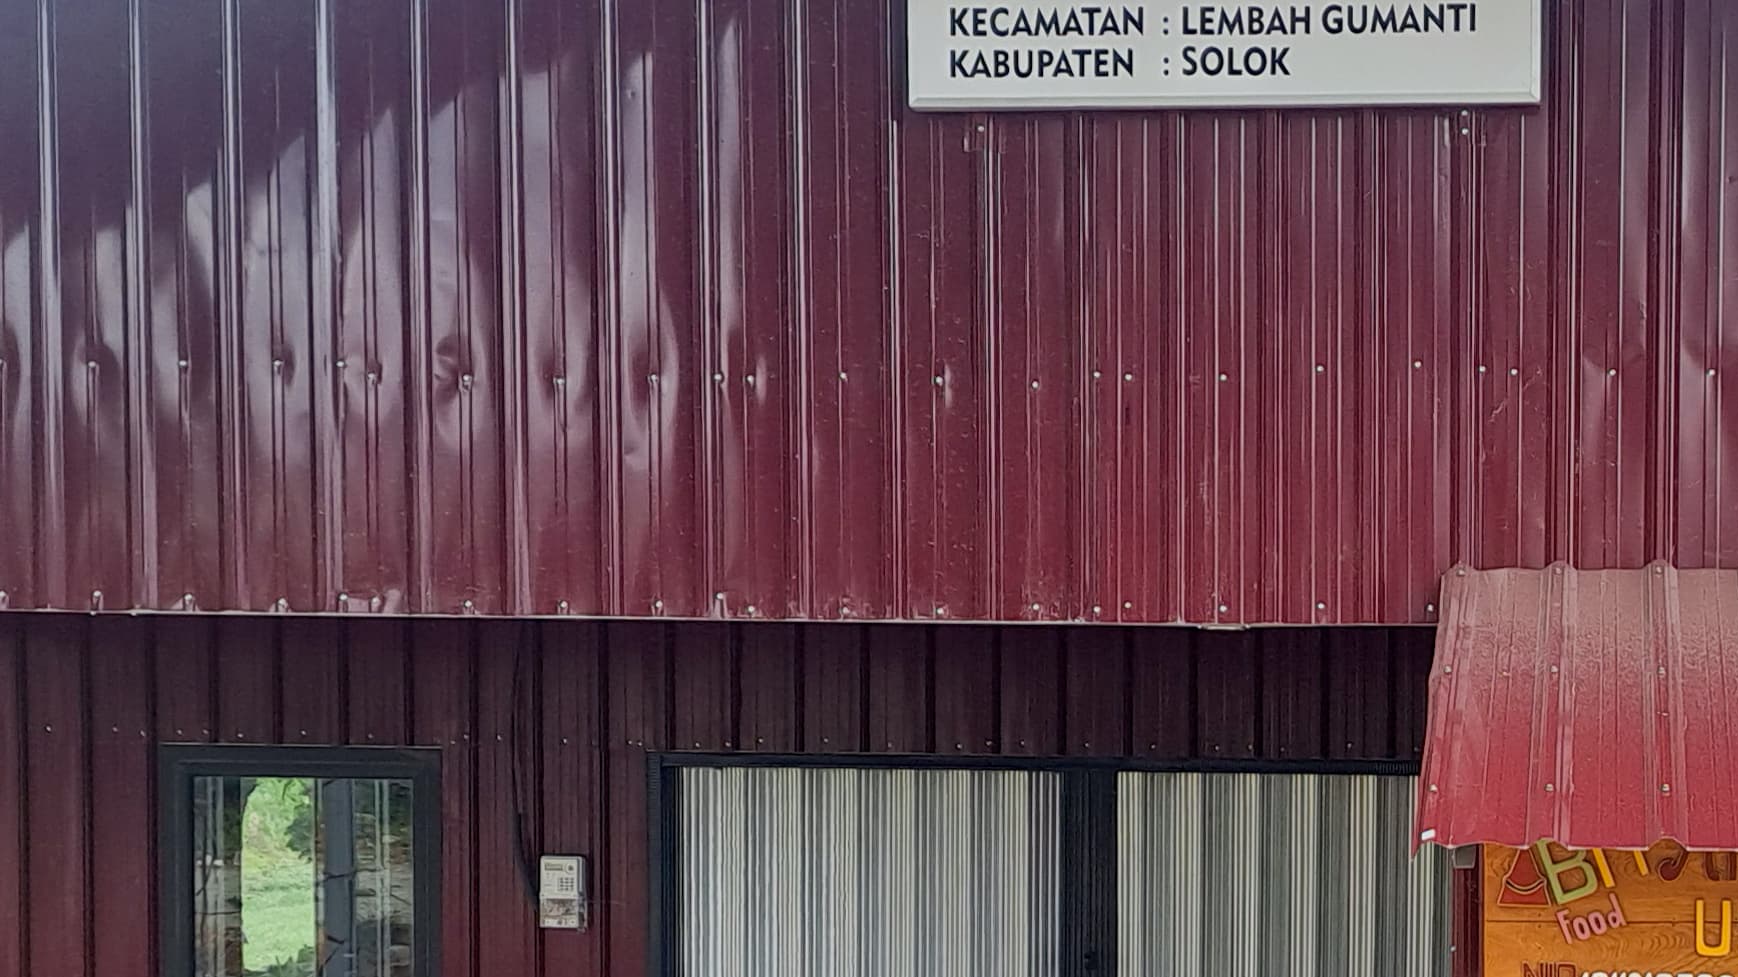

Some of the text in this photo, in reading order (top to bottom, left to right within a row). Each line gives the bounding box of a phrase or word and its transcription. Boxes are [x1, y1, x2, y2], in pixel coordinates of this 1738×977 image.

[949, 6, 1144, 36] KECAMATAN
[1182, 5, 1311, 35] LEMBAH
[1321, 3, 1477, 34] GUMANTI
[949, 48, 1134, 78] KABUPATEN
[1181, 46, 1291, 76] SOLOK
[1555, 893, 1627, 946] Food
